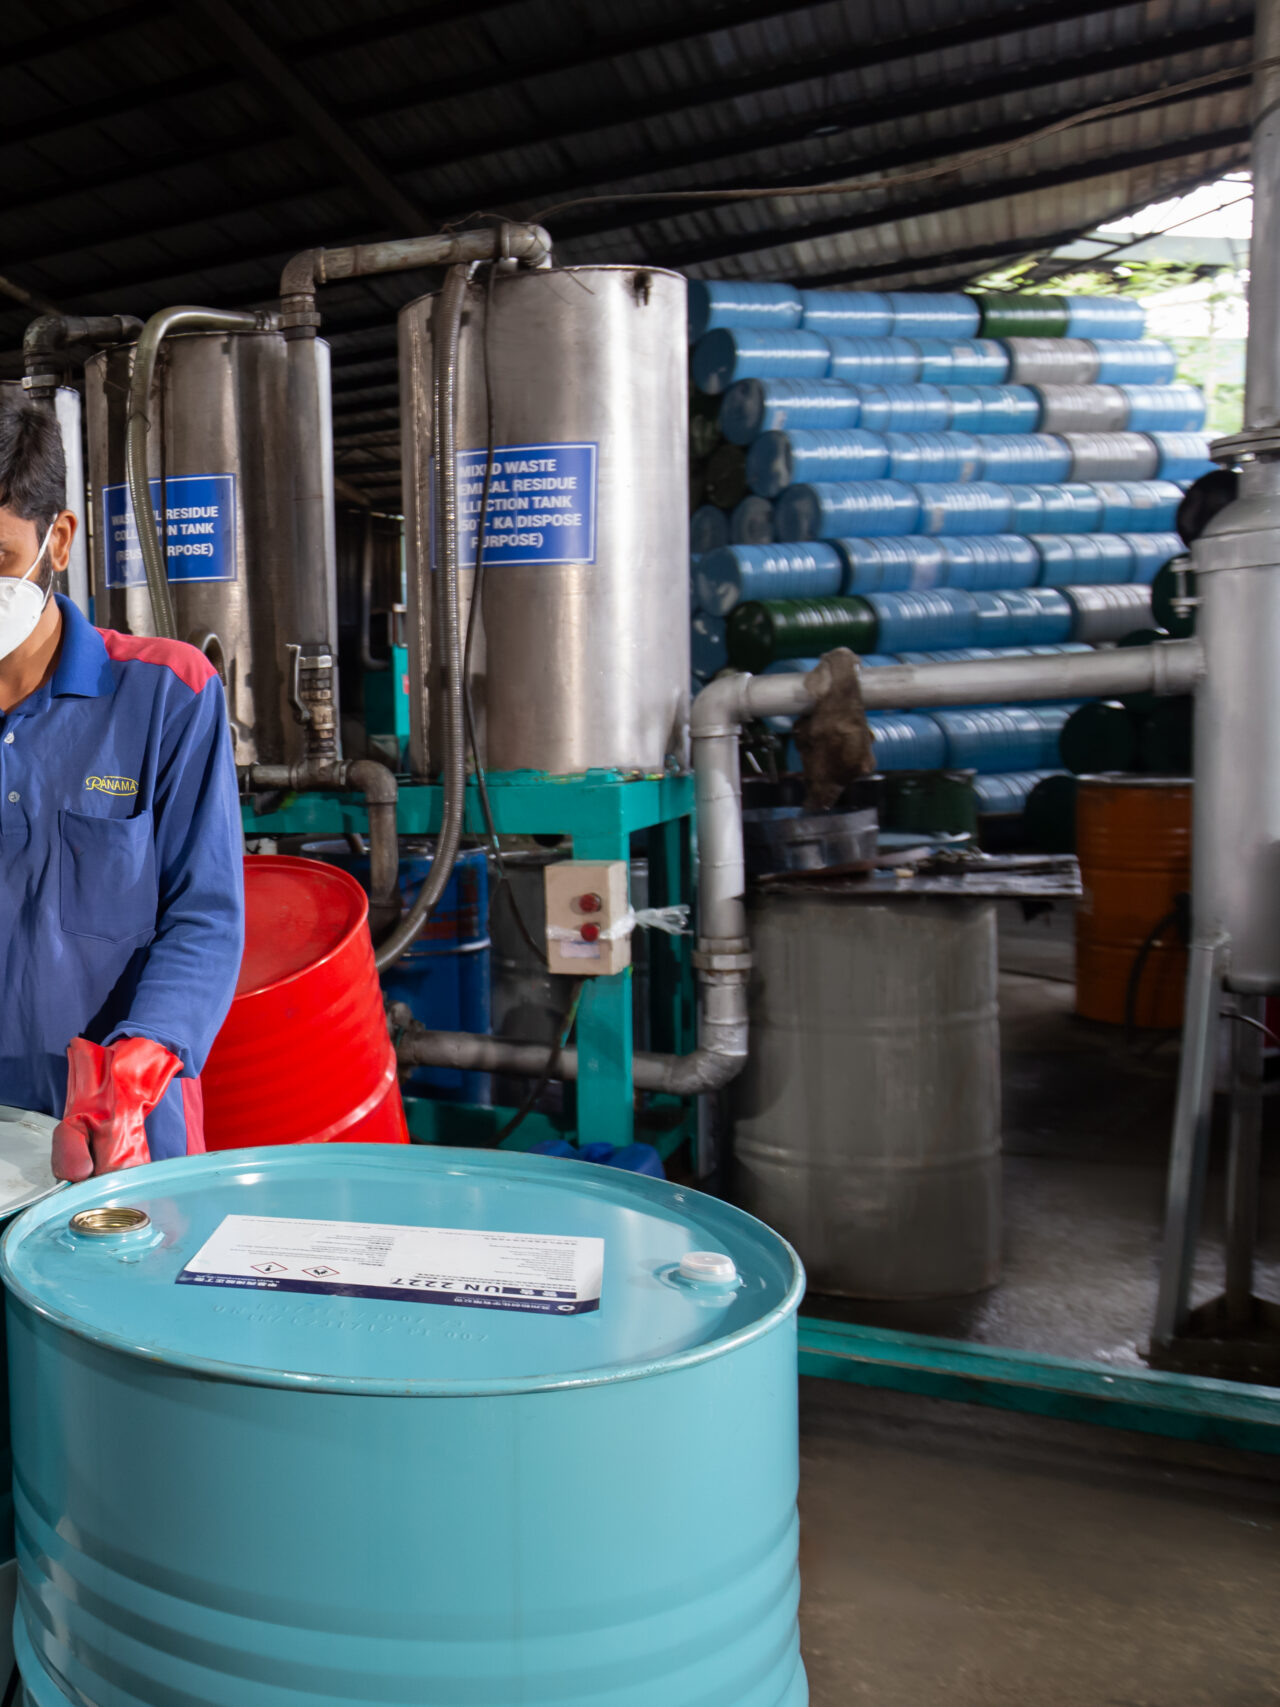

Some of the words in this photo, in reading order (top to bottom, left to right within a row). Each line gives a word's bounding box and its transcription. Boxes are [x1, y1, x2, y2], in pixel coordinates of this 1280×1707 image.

[504, 459, 557, 473] WASTE
[513, 477, 577, 491] RESIDUE
[532, 496, 573, 509] TANK
[165, 506, 219, 520] RESIDUE
[180, 522, 215, 535] TANK
[492, 516, 514, 530] KA
[517, 514, 582, 528] DISPOSE
[391, 1278, 453, 1290] 2227
[463, 1283, 501, 1293] UN
